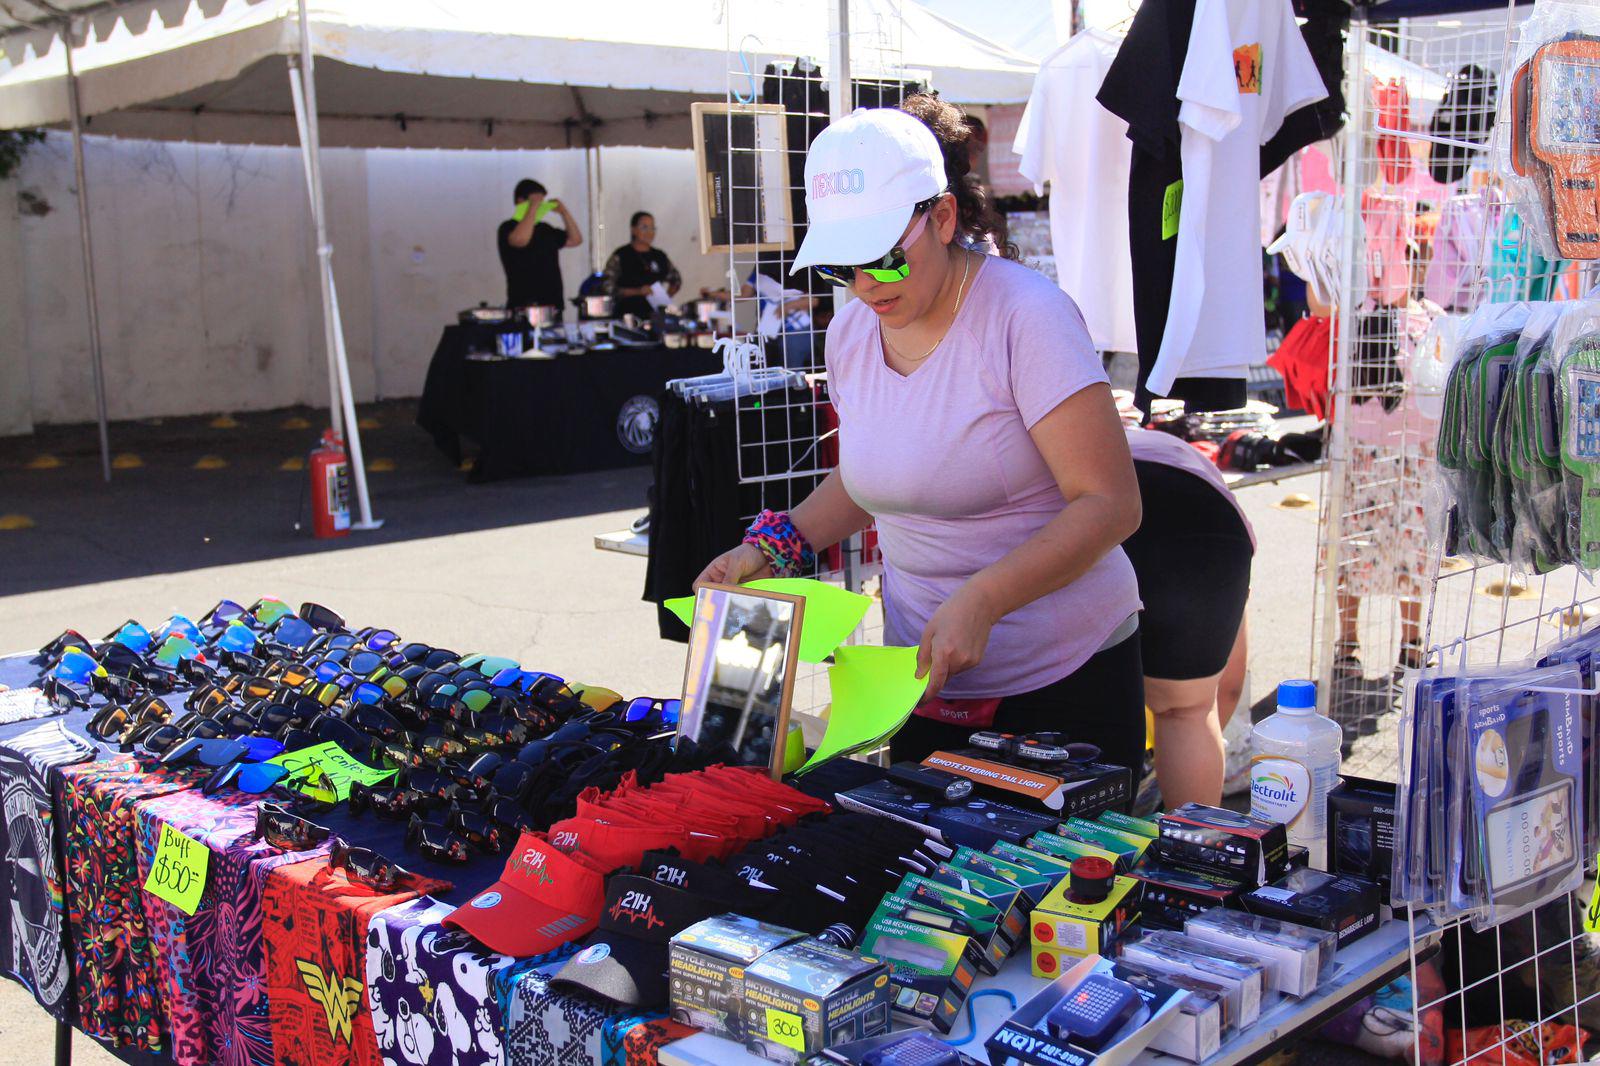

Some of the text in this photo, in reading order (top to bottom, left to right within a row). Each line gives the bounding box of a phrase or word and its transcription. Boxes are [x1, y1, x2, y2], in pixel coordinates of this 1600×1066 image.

[940, 708, 969, 720] SPORT
[1478, 704, 1501, 717] sports
[1555, 725, 1566, 766] sports
[928, 757, 1046, 790] REMOTE STEERING TAIL LIGHT
[1250, 777, 1297, 803] lectrolit
[164, 828, 192, 859] Buff
[552, 831, 578, 847] 21K
[522, 848, 547, 869] 21K
[656, 864, 687, 886] 21K
[621, 889, 651, 912] 21K
[881, 918, 892, 926] USB
[671, 949, 706, 967] BICYCLE
[671, 958, 724, 982] HEADLIGHTS
[745, 979, 780, 998] BICYCLE
[745, 988, 799, 1014] HEADLIGHTS
[803, 1000, 818, 1010] NEW
[828, 990, 876, 1021] HEADLIGHTS
[772, 1018, 800, 1037] 300
[994, 1028, 1045, 1054] NQY
